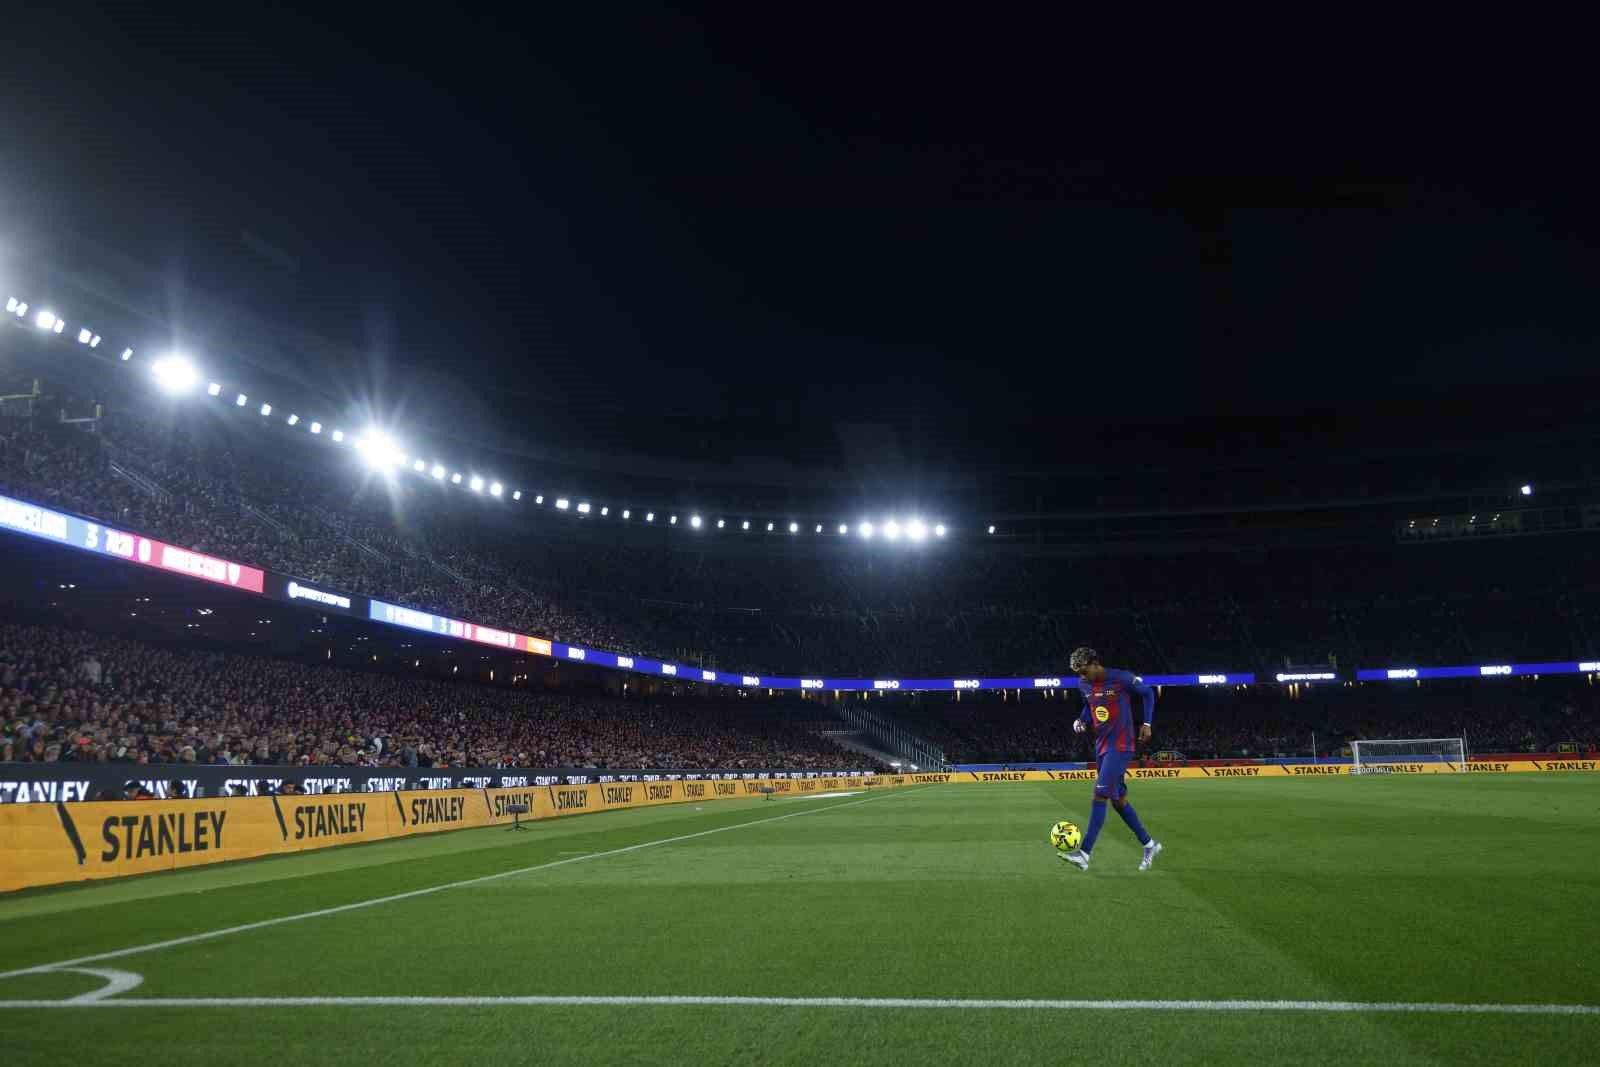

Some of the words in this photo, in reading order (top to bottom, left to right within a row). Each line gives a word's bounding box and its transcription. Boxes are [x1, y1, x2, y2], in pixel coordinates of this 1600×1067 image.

[1214, 767, 1259, 777] STANLEY
[1295, 766, 1340, 775] STANLEY
[1545, 762, 1596, 771] STANLEY
[983, 773, 1025, 781] STANLEY
[1058, 772, 1096, 780] STANLE
[1136, 769, 1180, 778] STANLEY
[607, 786, 633, 804] STANLEY
[649, 784, 673, 800] STANLEY
[558, 789, 588, 809] STANLEY
[411, 796, 464, 825] STANLEY
[295, 803, 366, 840] STANLEY
[102, 811, 227, 862] STANLEY
